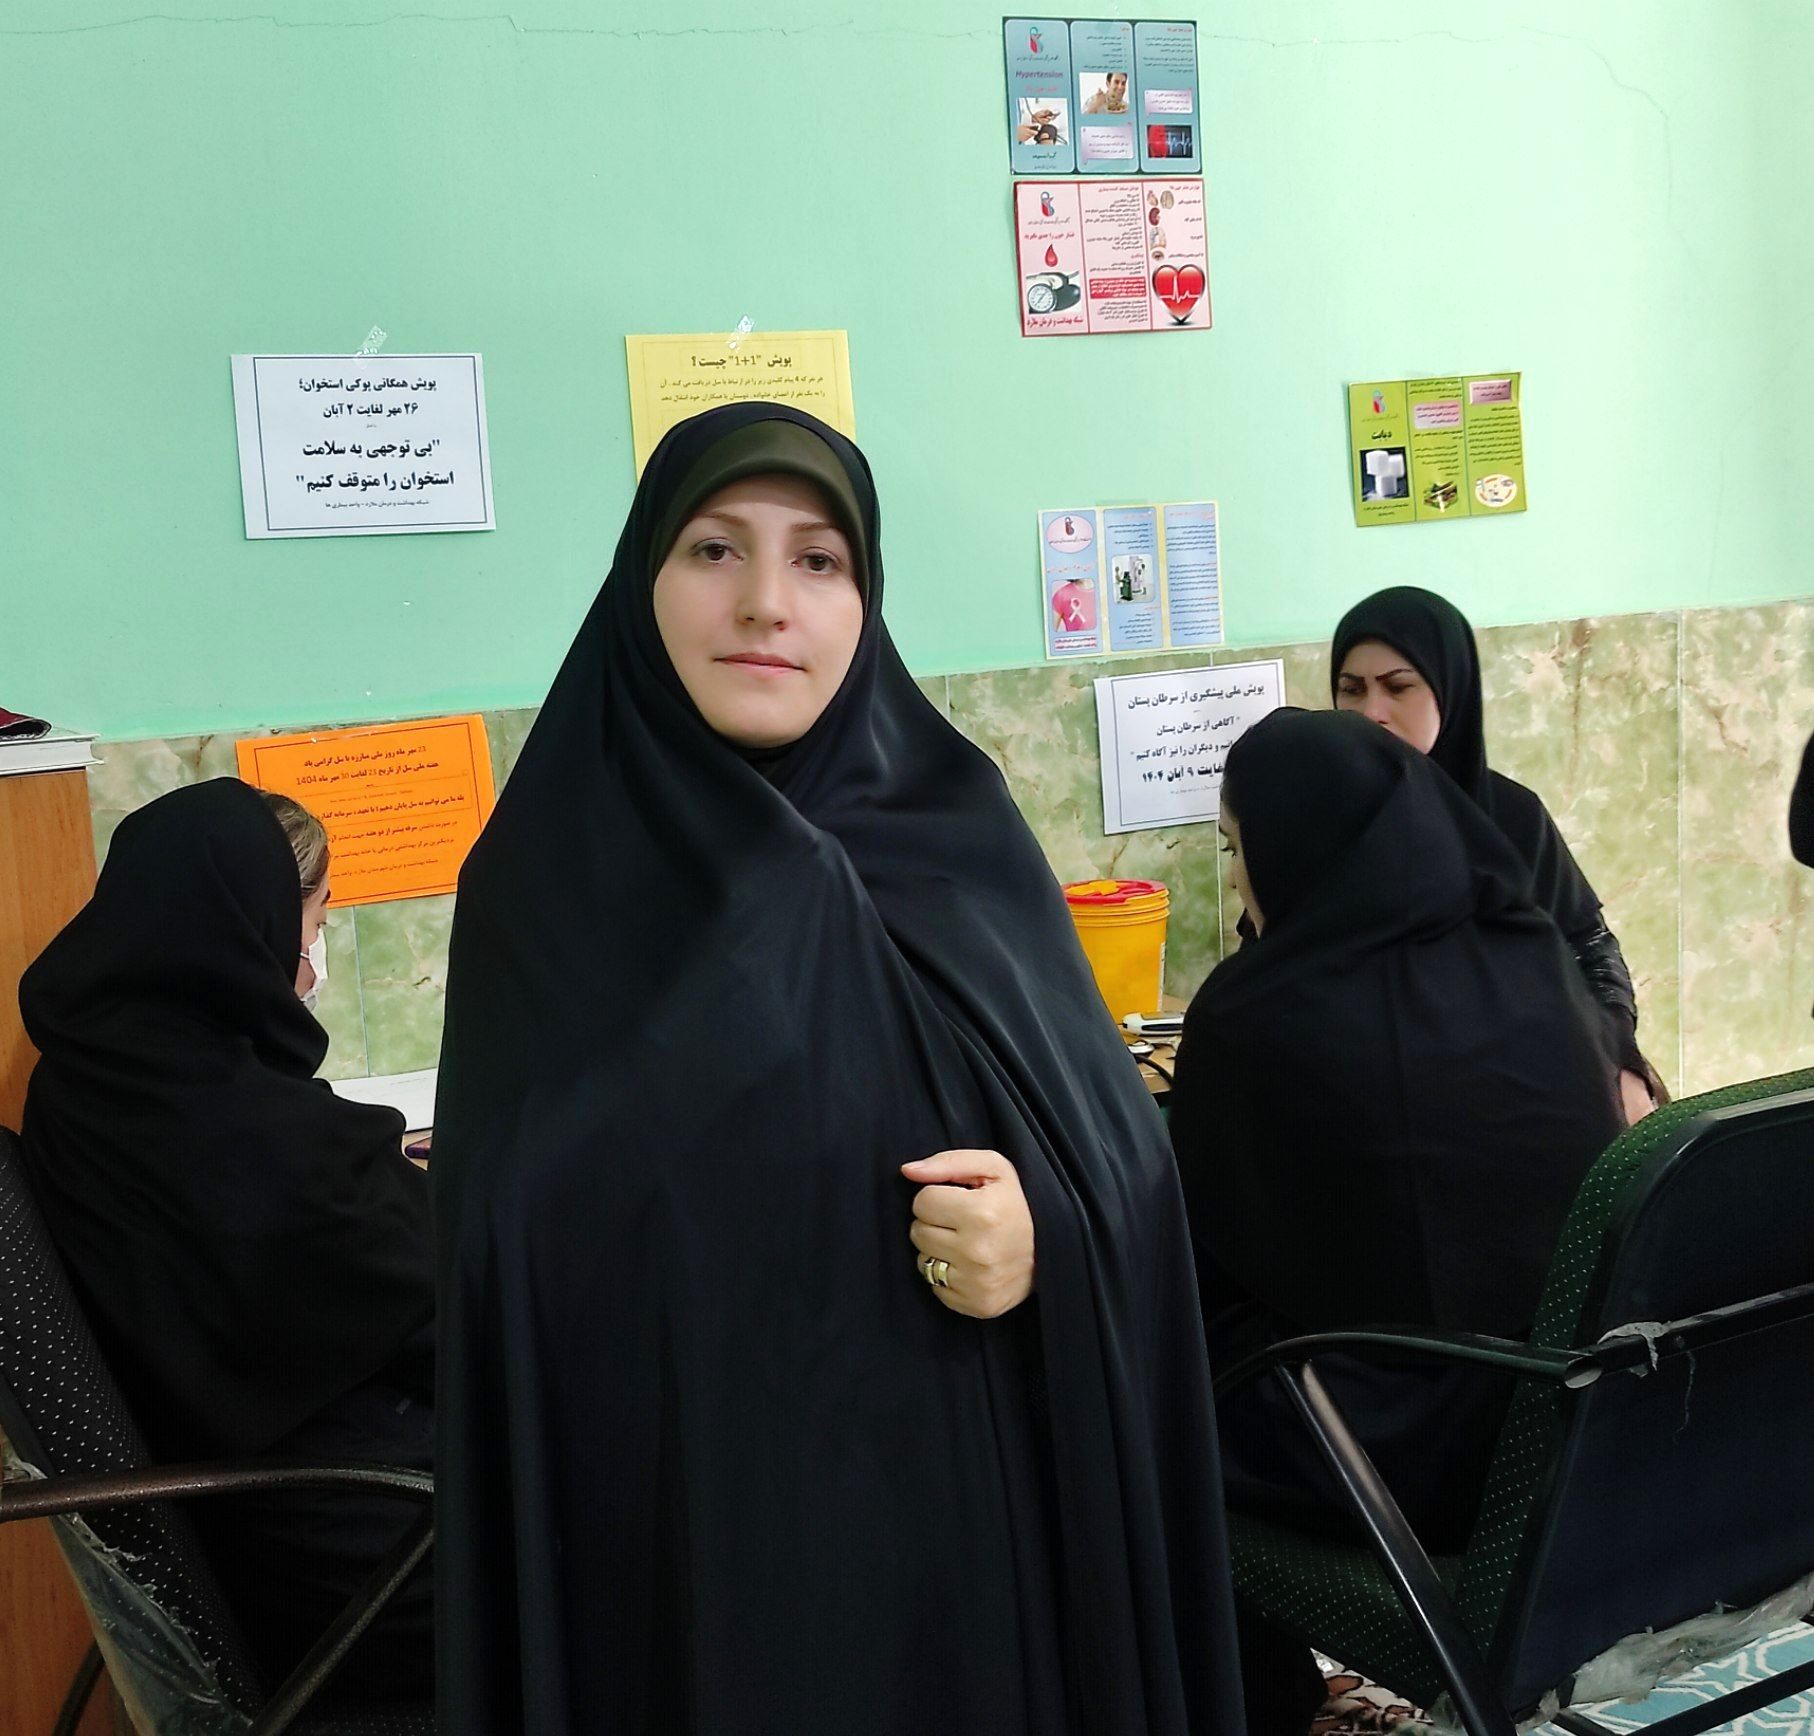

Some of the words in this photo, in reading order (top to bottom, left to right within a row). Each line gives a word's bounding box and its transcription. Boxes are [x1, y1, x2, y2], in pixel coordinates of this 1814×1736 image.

[1015, 70, 1064, 79] Hypertension
[698, 358, 727, 369] چیست
[767, 354, 792, 368] پویش
[346, 378, 372, 392] پوکی
[373, 378, 409, 391] همگانی
[411, 377, 437, 391] پویش
[323, 403, 344, 418] آبان
[347, 403, 354, 415] ۲
[356, 403, 383, 417] لغایت
[386, 405, 402, 417] مهر
[404, 402, 419, 415] ۲۶
[302, 439, 346, 456] سلامت
[349, 443, 363, 459] به
[338, 471, 381, 492] متوقف
[383, 472, 397, 491] را
[400, 470, 455, 491] استخوان
[1180, 690, 1188, 704] از
[1190, 688, 1224, 703] پیشگیری
[1225, 685, 1241, 699] ملی
[1127, 695, 1151, 709] بستان
[1151, 693, 1179, 707] سرطان
[1176, 722, 1202, 734] سرطان
[1202, 720, 1210, 732] از
[1211, 716, 1235, 730] آگاهی
[1156, 725, 1176, 736] بستان
[1136, 749, 1151, 761] کنیم
[1152, 745, 1167, 757] آگاه
[1180, 745, 1187, 757] را
[1188, 743, 1213, 756] دیگران
[1214, 744, 1219, 753] و
[1187, 766, 1194, 777] ۹
[1197, 762, 1225, 777] غایت
